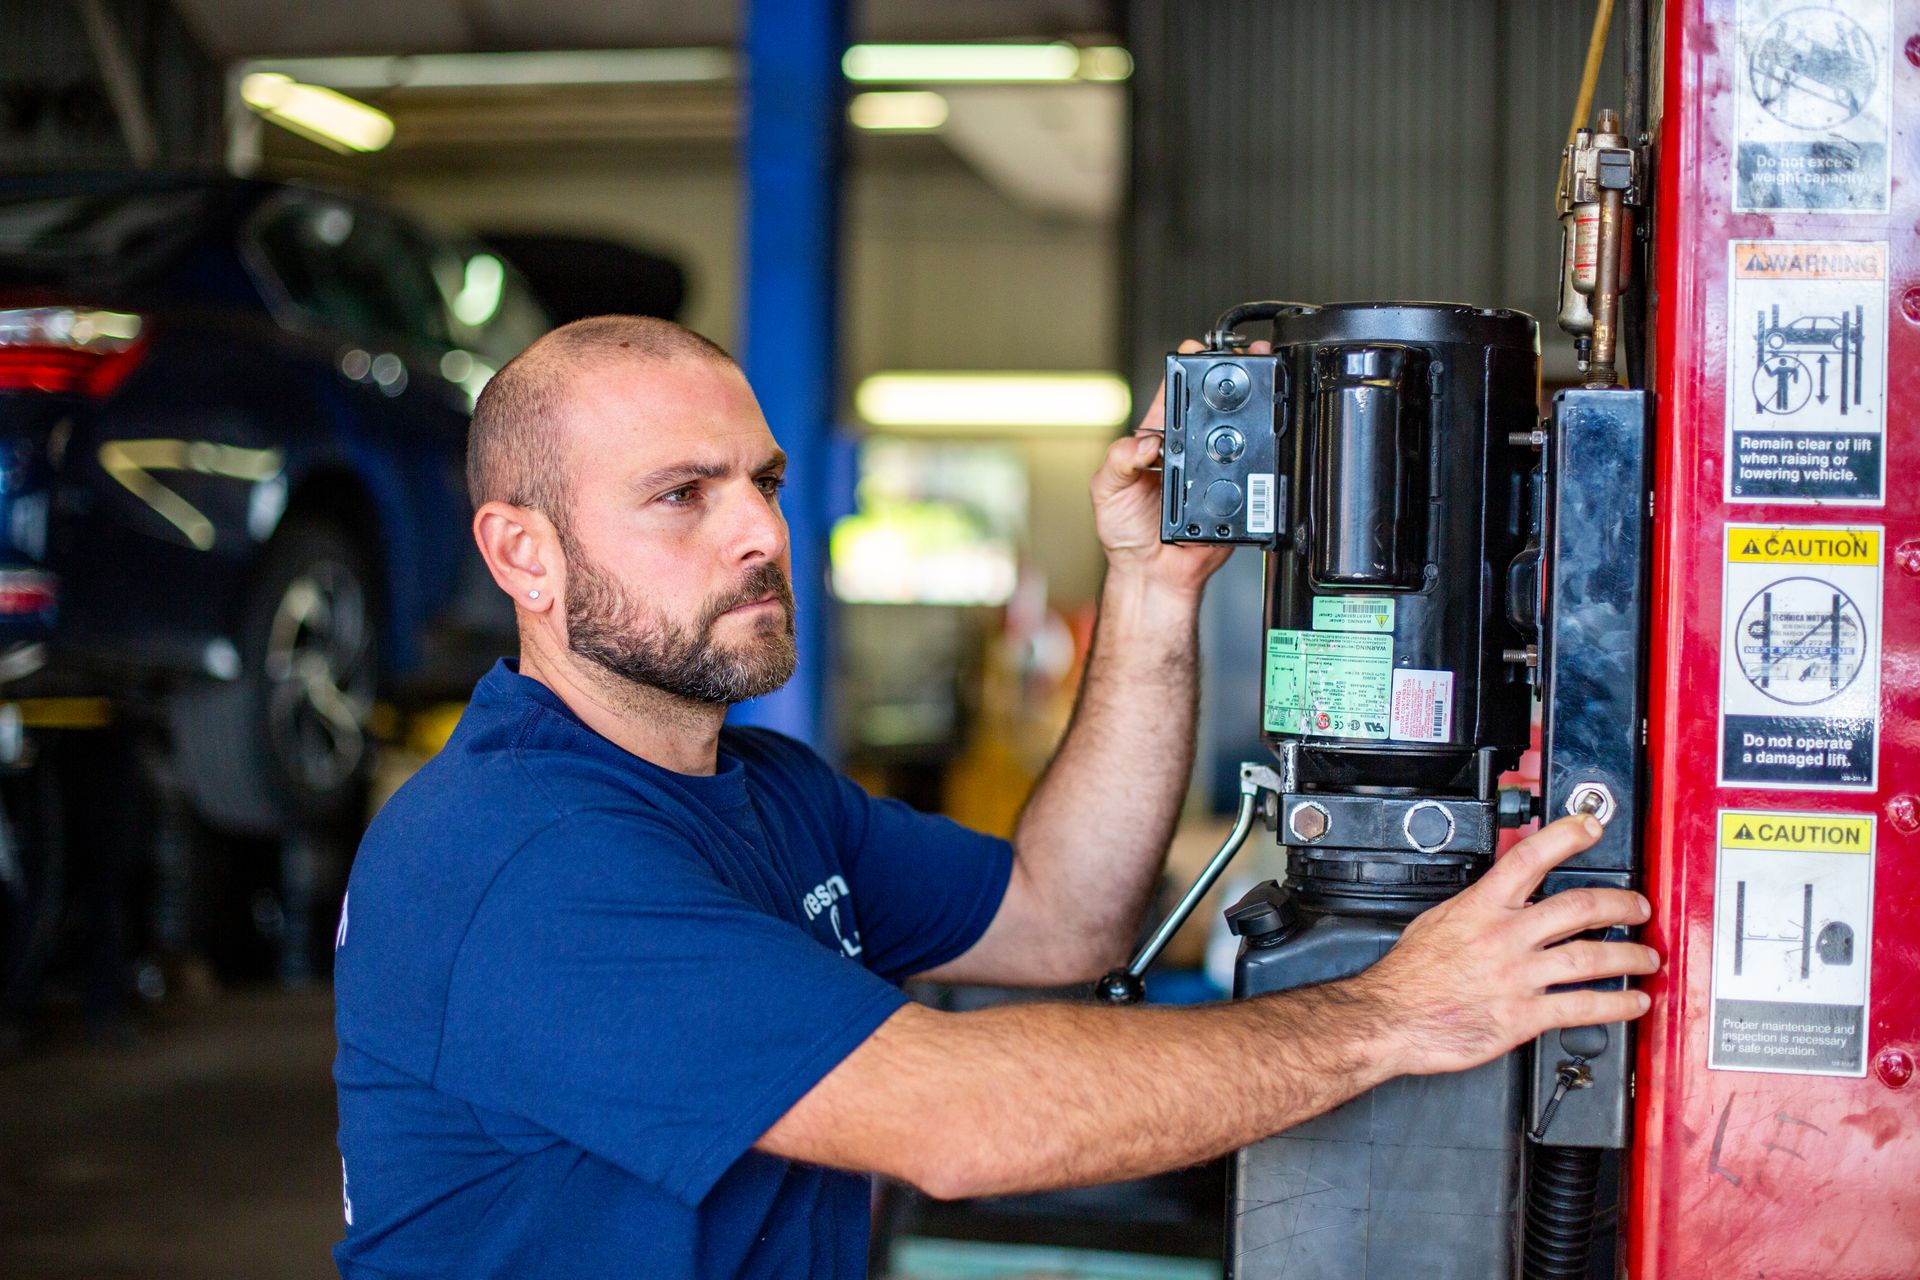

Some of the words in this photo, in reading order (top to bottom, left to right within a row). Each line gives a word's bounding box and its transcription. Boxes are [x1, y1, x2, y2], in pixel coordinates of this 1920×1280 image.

[1756, 154, 1776, 167] Do
[1781, 156, 1804, 168] not
[1752, 171, 1801, 186] weight
[1766, 253, 1878, 273] WARNING
[1740, 436, 1793, 450] Remain
[1797, 438, 1832, 450] clear
[1836, 438, 1850, 451] of
[1854, 439, 1873, 452] lift
[1740, 453, 1777, 465] when
[1781, 453, 1829, 468] raising
[1833, 456, 1848, 466] or
[1740, 468, 1800, 483] lowering
[1803, 469, 1858, 481] vehicle.
[1764, 538, 1868, 558] CAUTION
[1743, 733, 1764, 747] Do
[1768, 734, 1793, 748] not
[1796, 736, 1853, 752] operate
[1743, 753, 1752, 763] a
[1756, 750, 1824, 767] damaged
[1827, 752, 1851, 767] lift.
[1758, 823, 1860, 845] CAUTION
[1723, 1018, 1760, 1032] Proper
[1762, 1021, 1831, 1034] maintenance
[1834, 1022, 1855, 1035] and
[1723, 1031, 1777, 1045] inspection
[1780, 1031, 1789, 1043] is
[1792, 1034, 1847, 1048] necessary
[1721, 1041, 1735, 1052] for
[1738, 1042, 1761, 1054] safe
[1764, 1043, 1818, 1057] operation.
